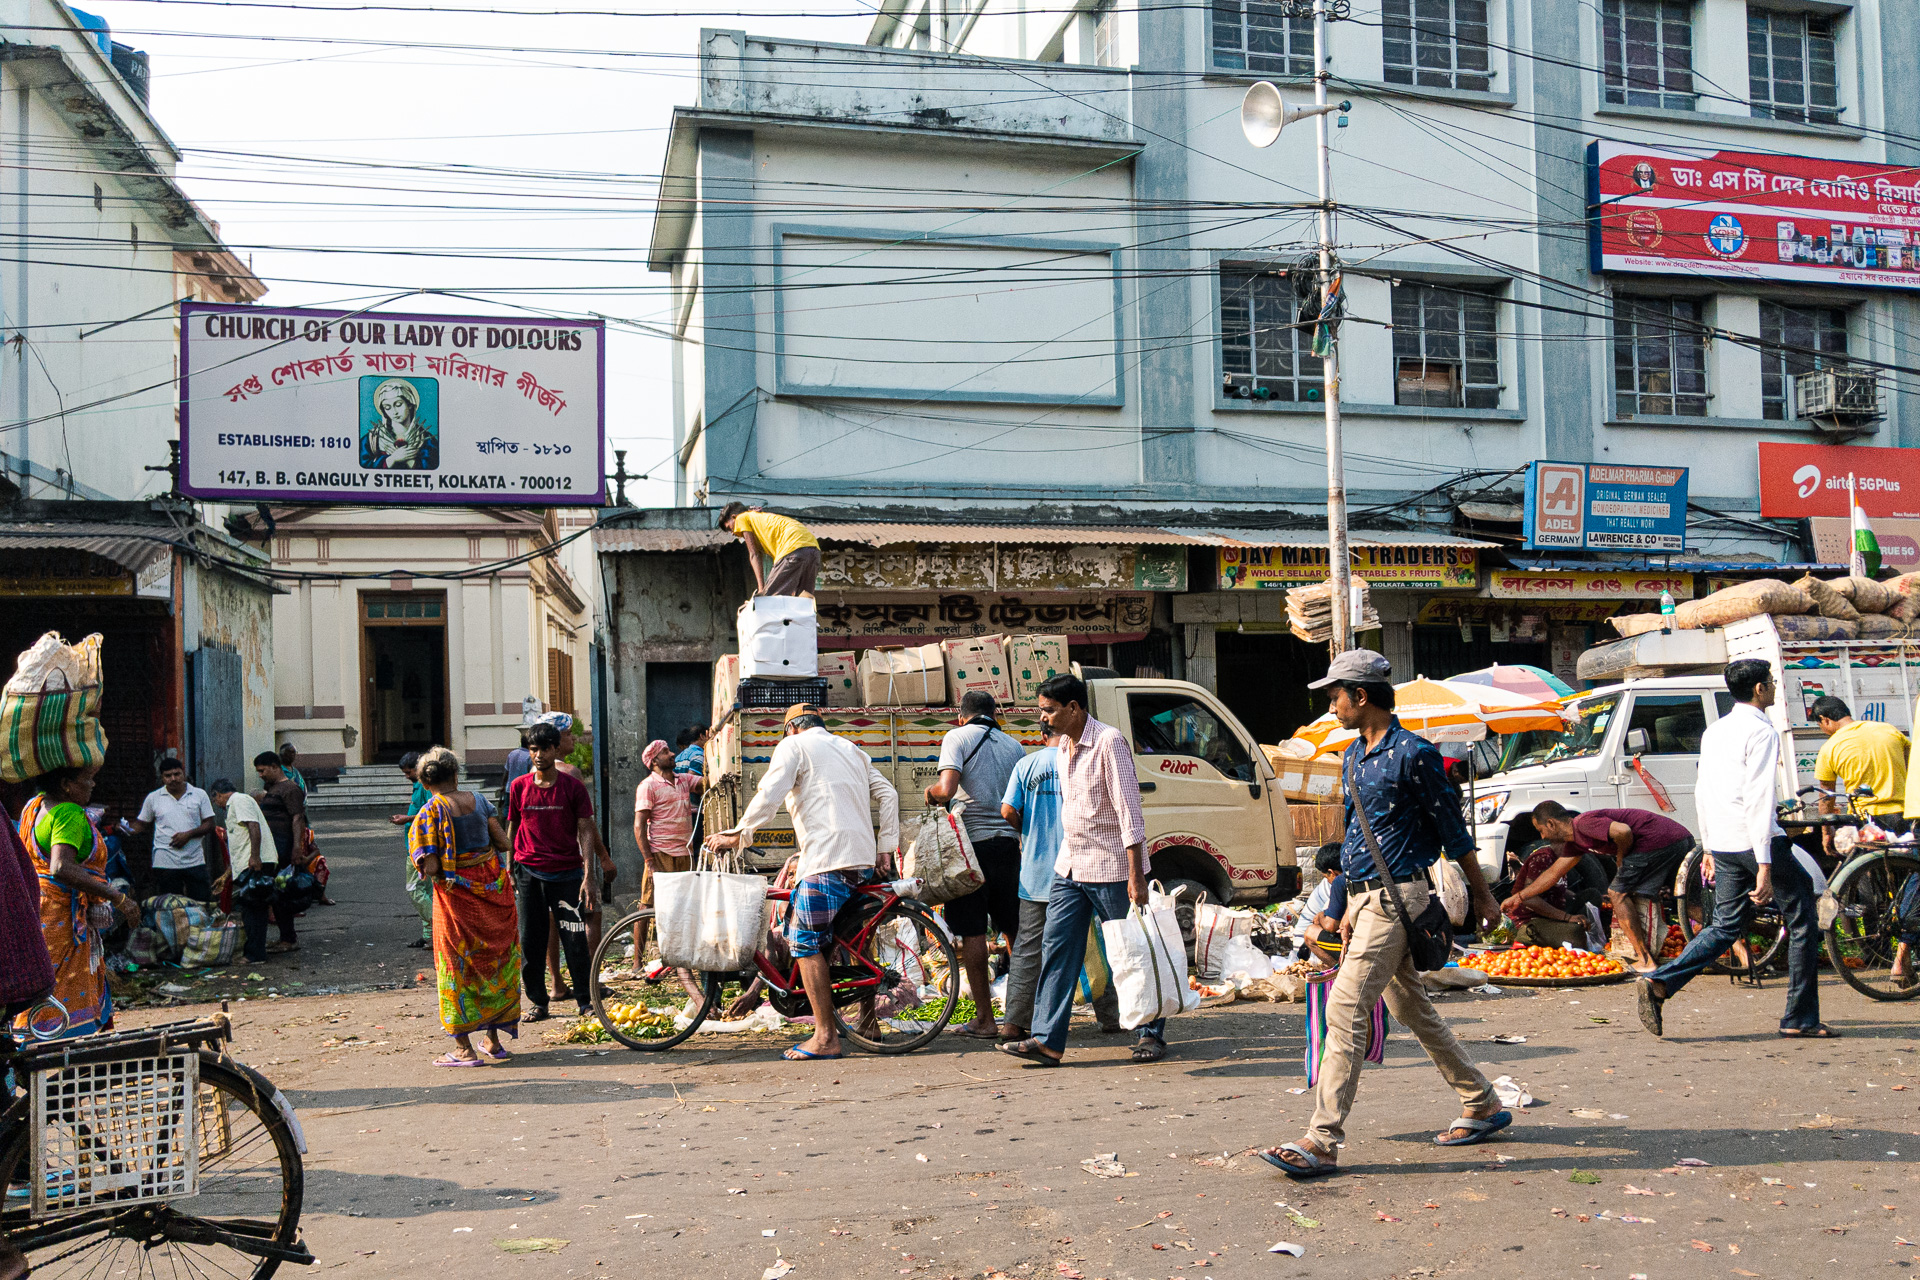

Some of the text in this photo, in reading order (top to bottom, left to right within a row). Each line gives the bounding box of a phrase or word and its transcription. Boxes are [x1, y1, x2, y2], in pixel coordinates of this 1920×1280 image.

[1671, 166, 1702, 187] ডাঃ
[1709, 170, 1739, 190] এস
[1744, 168, 1766, 192] সি
[1772, 176, 1804, 196] দেব
[1811, 174, 1870, 201] হোমিও
[1624, 257, 1653, 266] Website:
[205, 315, 582, 351] CHURCH OF OUR LADY OF DOLOURS
[223, 347, 567, 416] সপ্ত শোকার্ত মাতা মারিয়ার গীর্জা
[218, 433, 351, 449] ESTABLISHED: 1810
[476, 437, 520, 455] স্থাপিত
[533, 443, 572, 455] ১৮১০
[218, 470, 250, 487] 147,
[255, 471, 271, 485] B.
[276, 471, 291, 486] B.
[296, 472, 369, 487] GANGULY
[374, 473, 434, 490] STREET,
[439, 475, 506, 489] KOLKATA
[520, 476, 571, 490] 700012
[1591, 468, 1675, 484] ADELMAR PHARMA GmbH
[1596, 490, 1667, 502] ORIGINAL GERMAN SEALED
[1639, 505, 1669, 515] MEDICINES
[1545, 518, 1575, 530] ADEL
[1606, 518, 1655, 528] THAT REALLY WORK
[1539, 535, 1580, 544] GERMANY
[1588, 533, 1635, 544] LAWRENCE
[1637, 534, 1643, 544] &
[1645, 535, 1657, 544] CO
[1225, 550, 1237, 560] KN
[1240, 547, 1274, 566] JAY
[1367, 547, 1459, 567] TRADERS
[1461, 551, 1473, 562] KN
[1902, 547, 1915, 556] 5G
[1501, 577, 1576, 593] লরেন্স
[1635, 578, 1683, 594] কোং
[816, 594, 1114, 628] কুসুম টি ট্রেডার্স
[863, 624, 885, 636] বিপিন
[900, 624, 926, 636] বিহারী
[1027, 625, 1063, 634] কলকাতা
[1072, 625, 1112, 633] ৭০০০১২
[1160, 759, 1199, 776] Pilot
